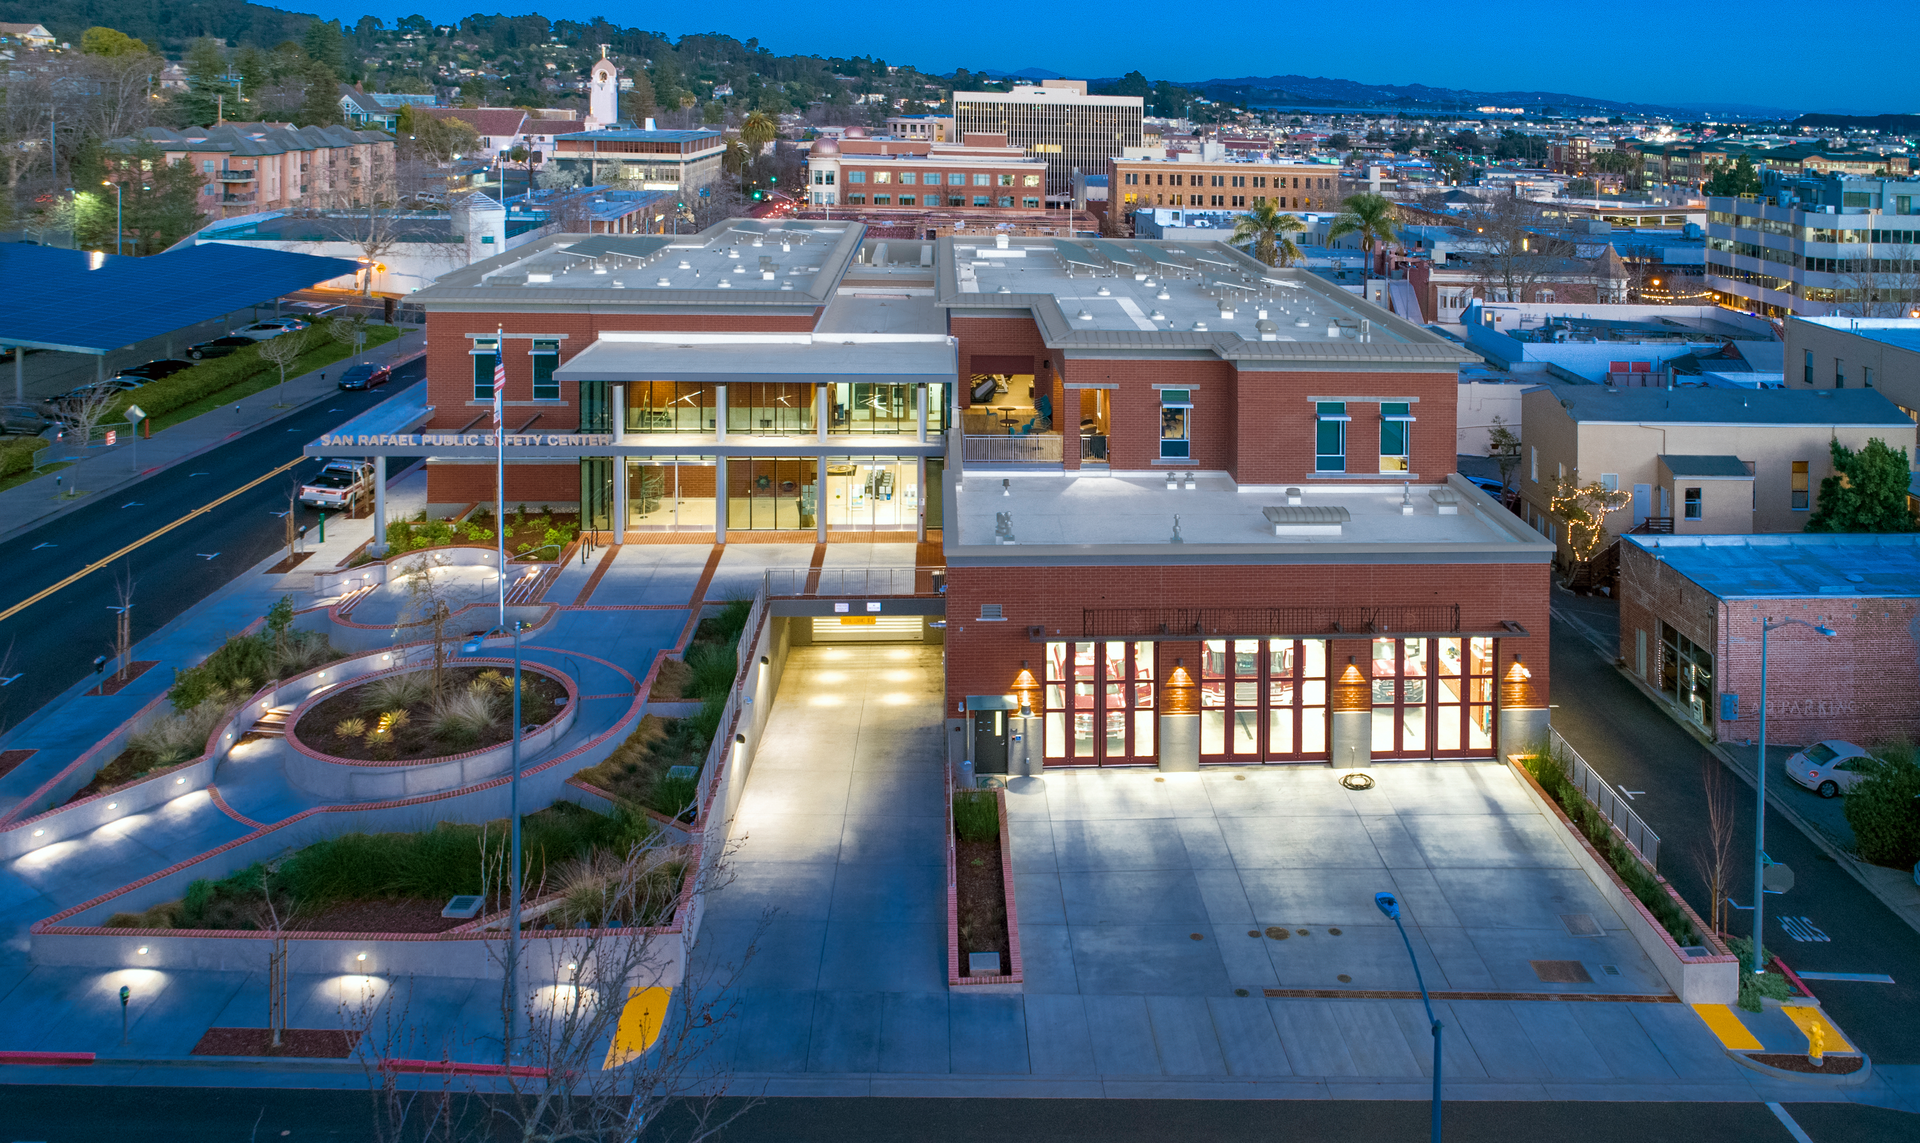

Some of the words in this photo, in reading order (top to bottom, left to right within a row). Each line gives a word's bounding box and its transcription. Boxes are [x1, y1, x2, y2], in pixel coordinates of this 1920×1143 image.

[320, 434, 354, 447] SAN
[358, 434, 417, 447] RAFAEL
[421, 434, 479, 447] PUBLIC
[484, 434, 543, 447] SFETY
[547, 434, 610, 447] CENTER
[1776, 915, 1831, 942] STOP
